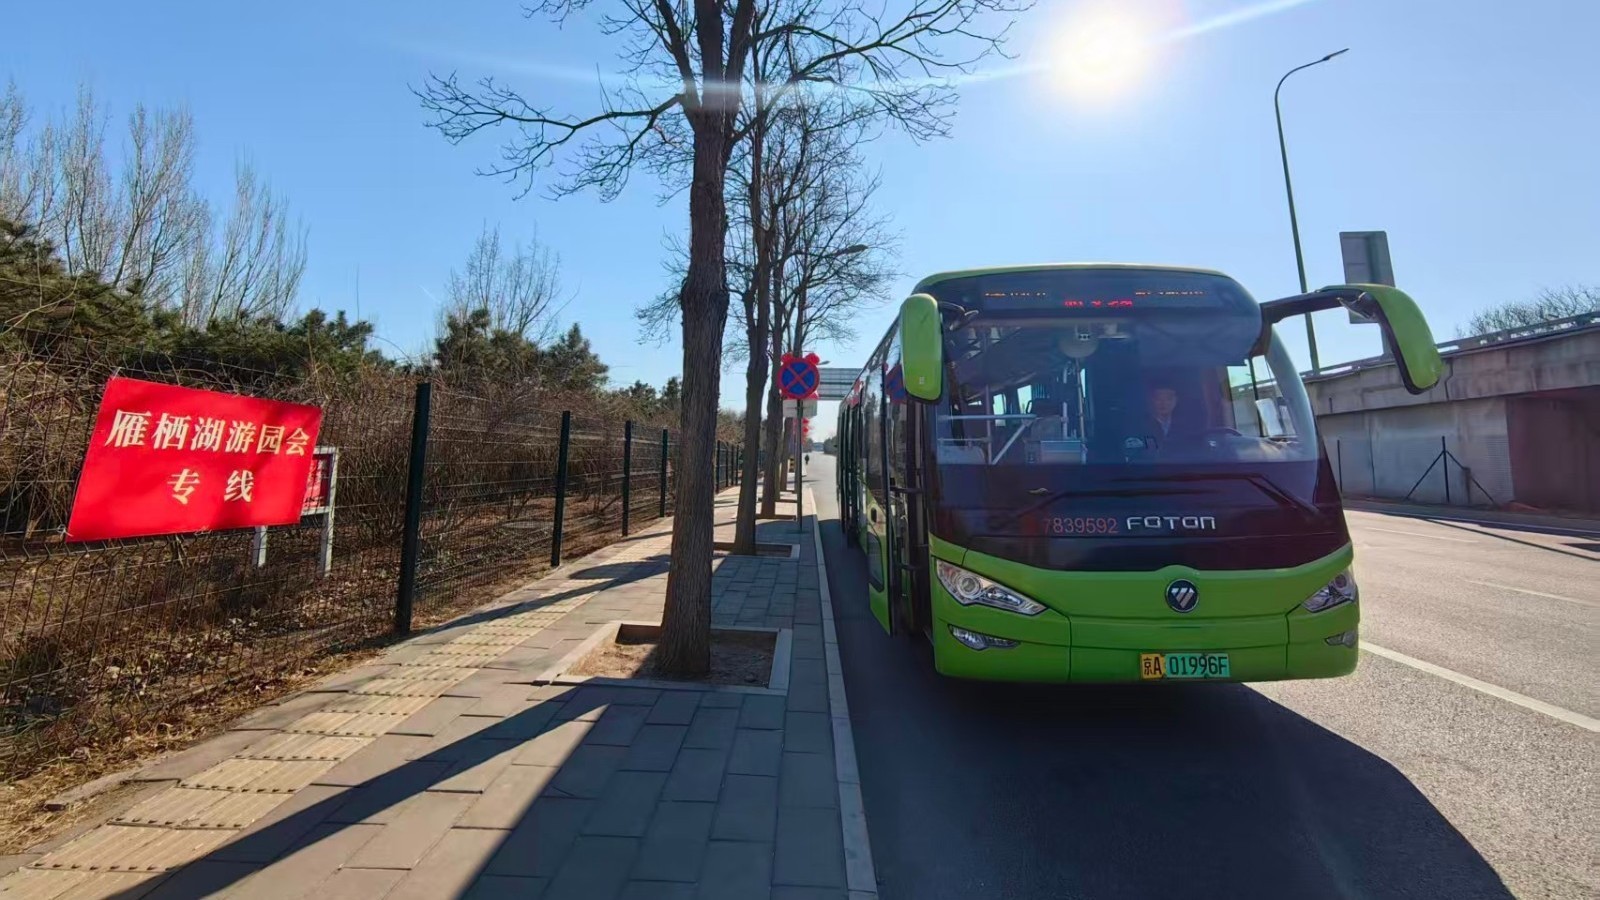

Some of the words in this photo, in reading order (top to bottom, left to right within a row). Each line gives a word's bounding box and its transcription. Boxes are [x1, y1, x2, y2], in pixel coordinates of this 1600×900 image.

[104, 408, 311, 457] 雁栖湖游园会
[167, 468, 255, 505] 专线
[1042, 517, 1119, 535] 7839592
